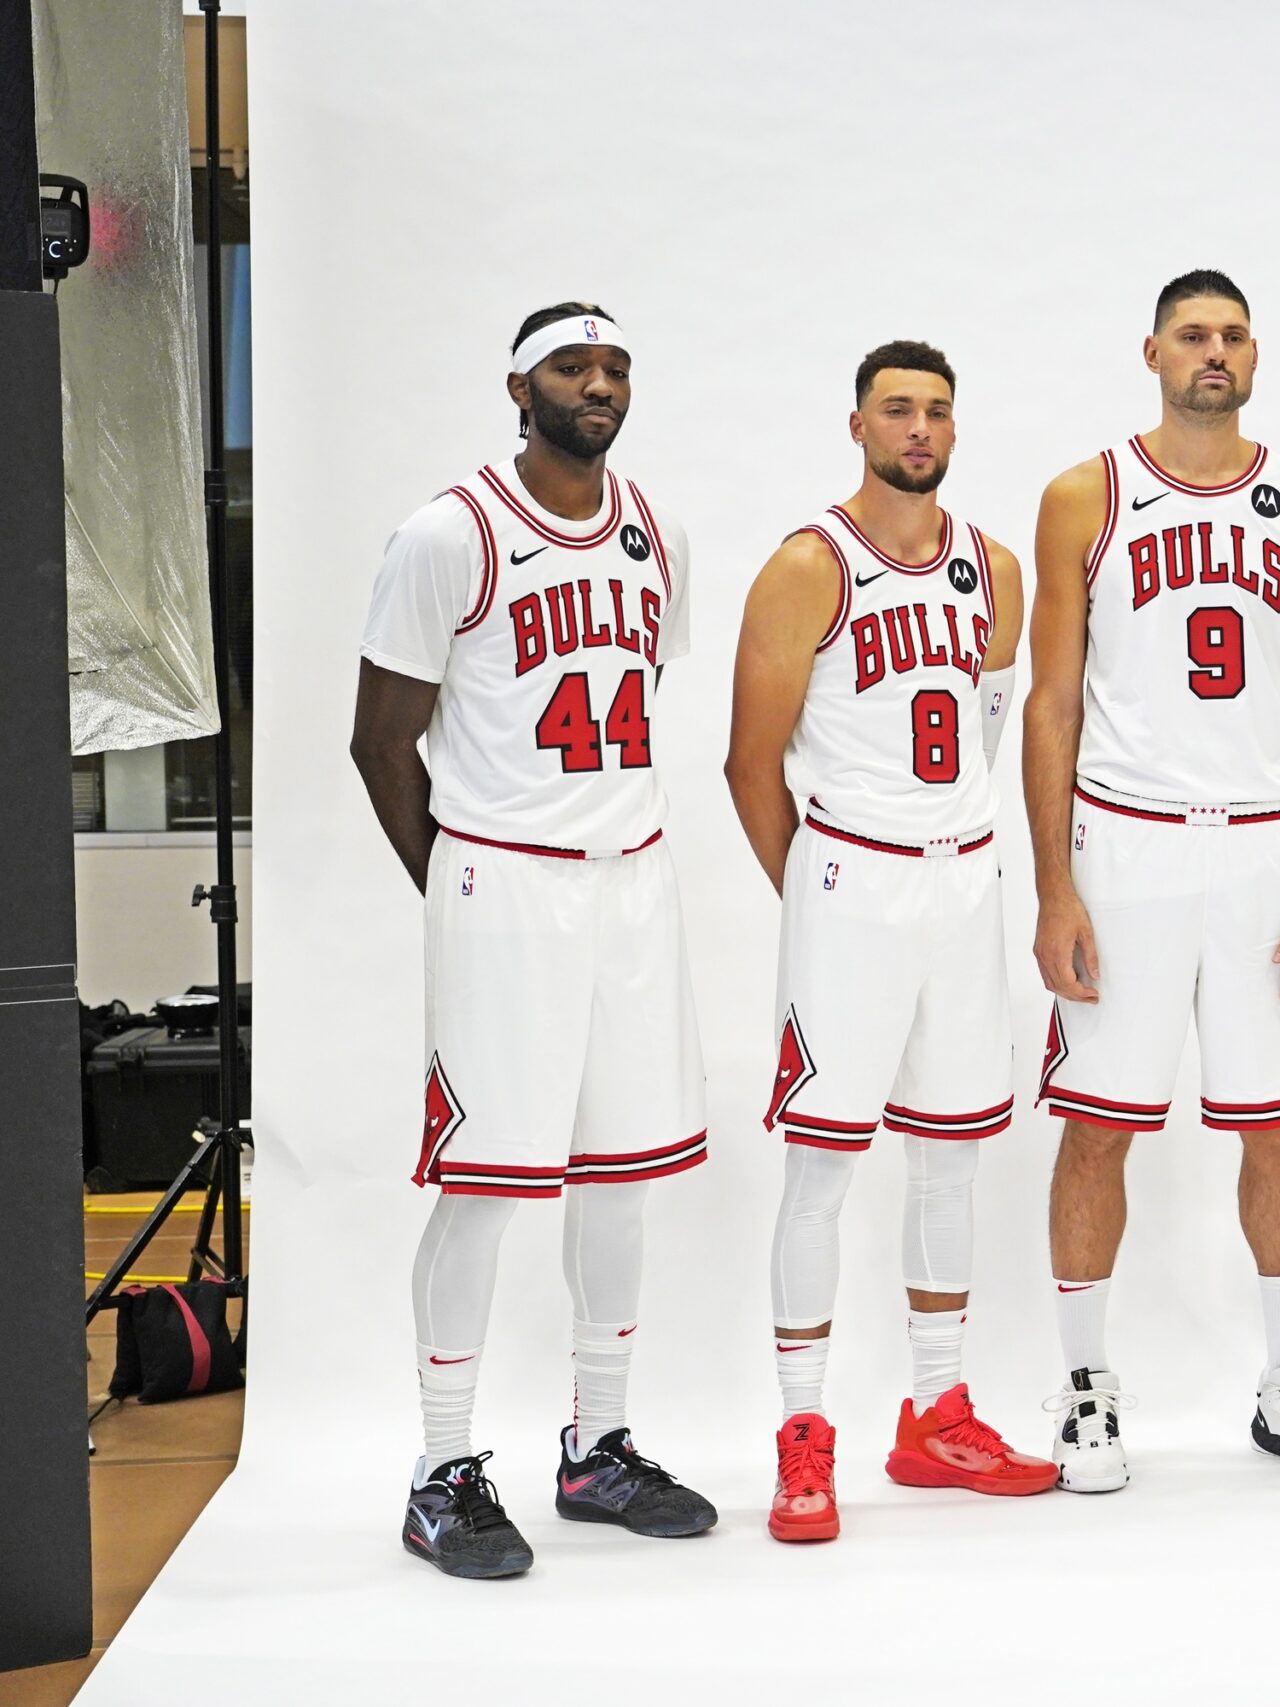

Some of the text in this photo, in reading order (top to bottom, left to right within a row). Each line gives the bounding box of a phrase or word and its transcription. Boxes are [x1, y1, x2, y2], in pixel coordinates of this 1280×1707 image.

[509, 578, 661, 678] BULLS
[850, 603, 990, 695] BULLS
[1186, 605, 1246, 700] 9
[535, 669, 652, 774] 44
[911, 689, 960, 784] 8
